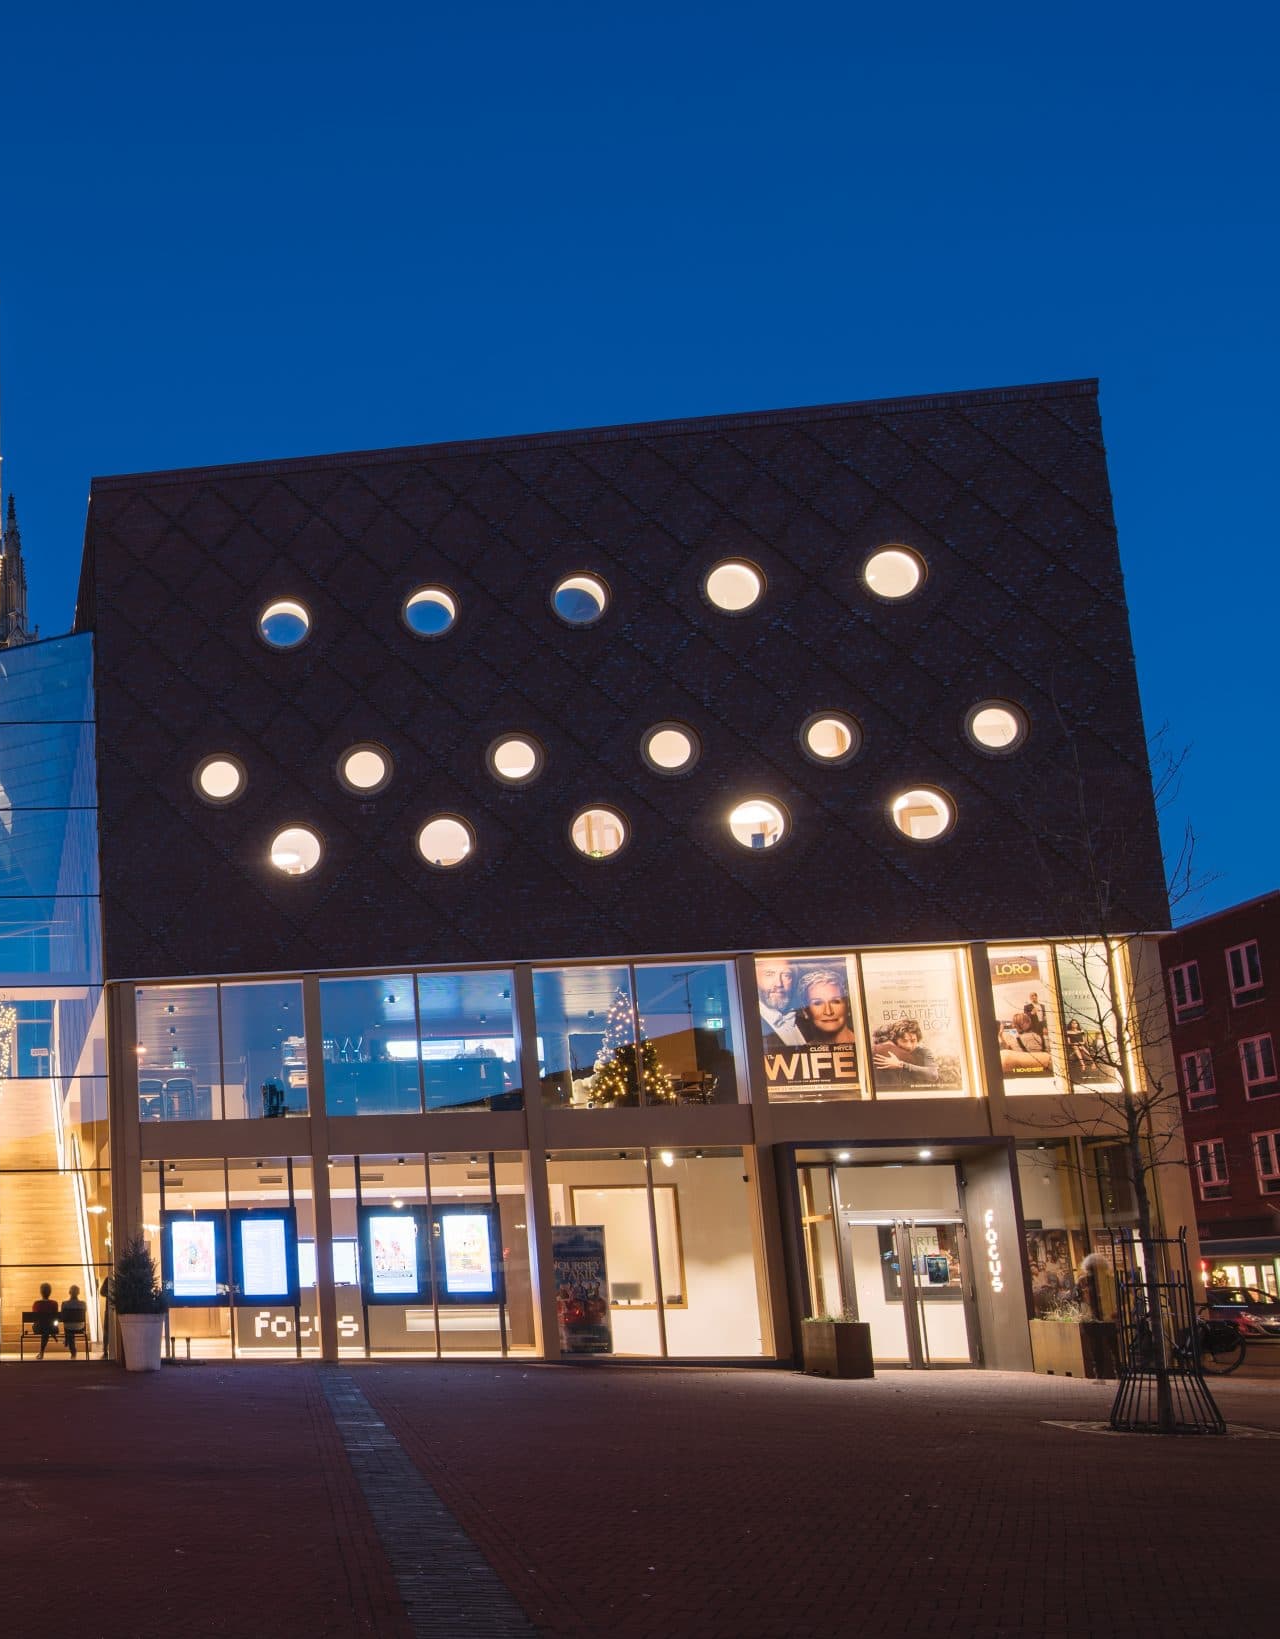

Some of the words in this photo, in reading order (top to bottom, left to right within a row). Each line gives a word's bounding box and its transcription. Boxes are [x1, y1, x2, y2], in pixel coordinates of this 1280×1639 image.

[995, 963, 1032, 976] LORO
[882, 1007, 952, 1021] BEAUTIFUL
[923, 1019, 952, 1031] BOY
[763, 1052, 857, 1081] WIFE
[984, 1209, 1004, 1293] FOCUS
[254, 1311, 360, 1338] FOCS
